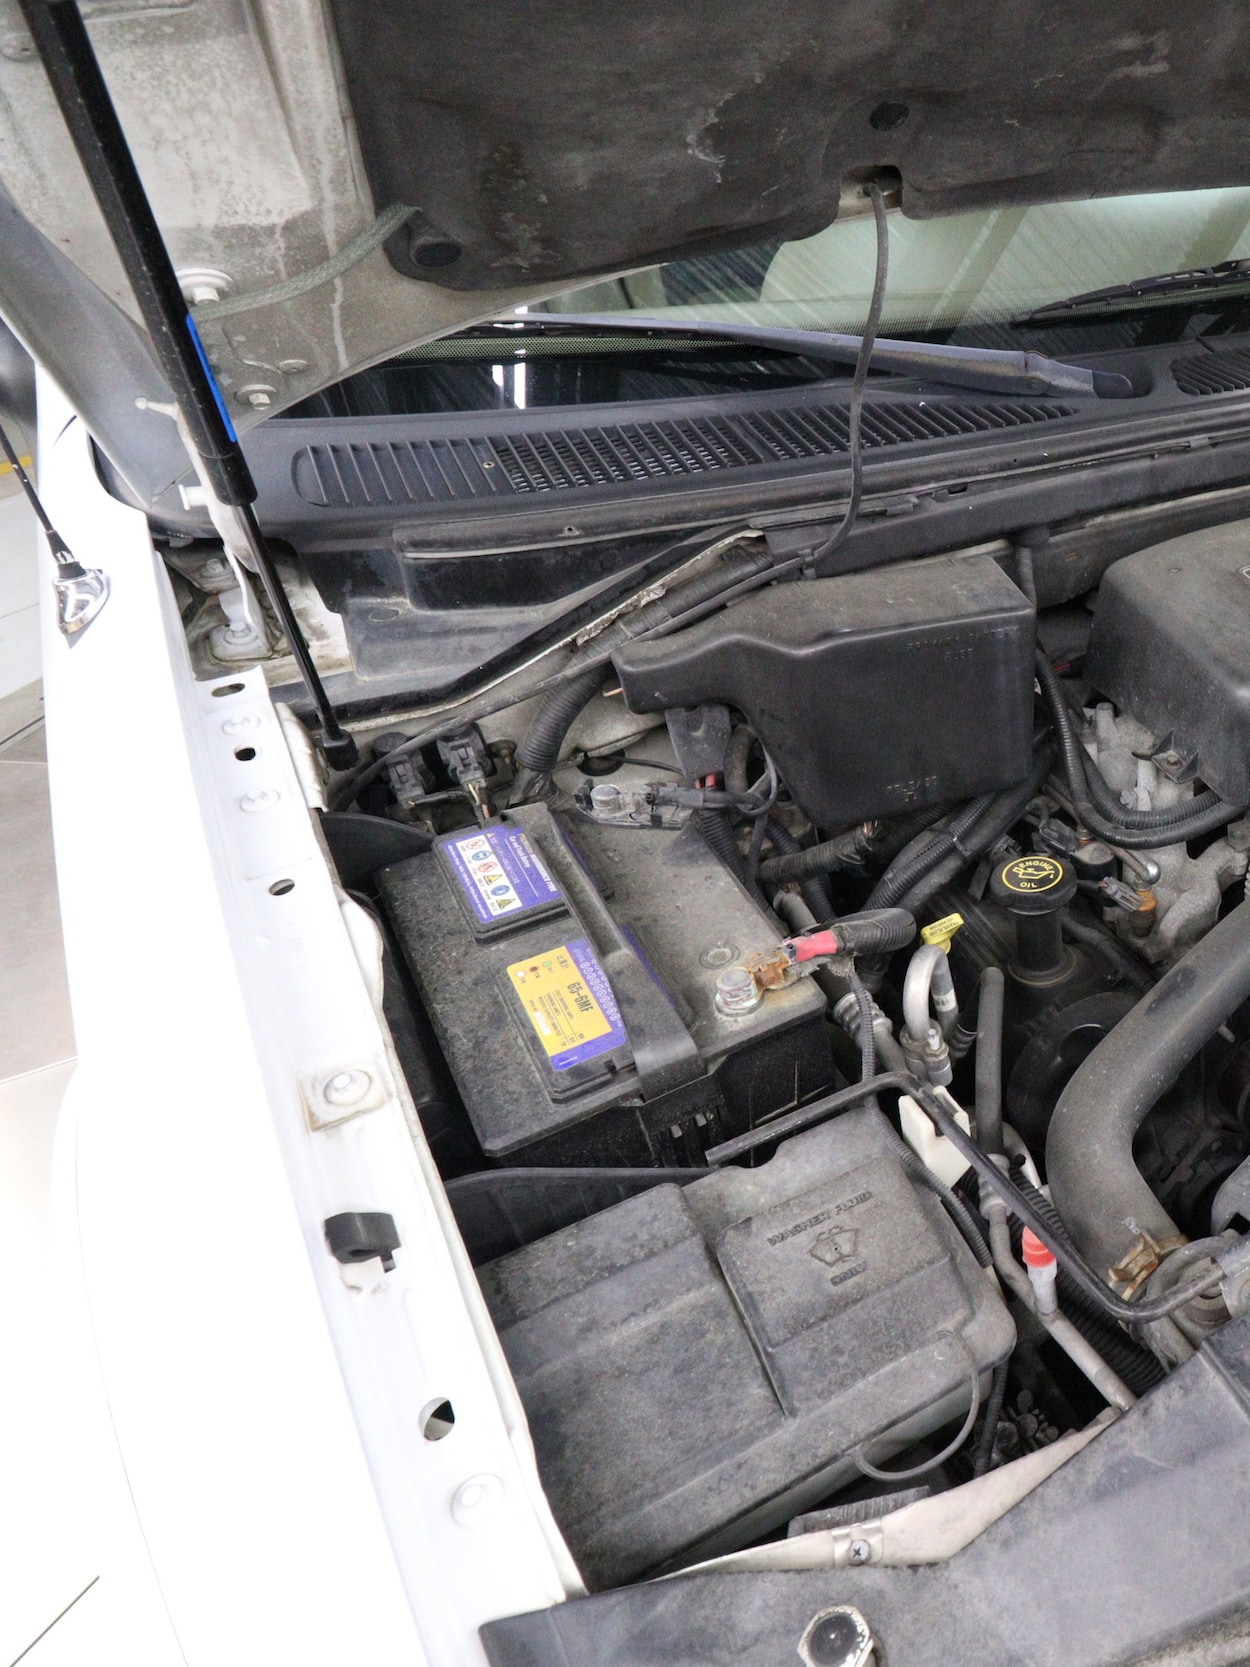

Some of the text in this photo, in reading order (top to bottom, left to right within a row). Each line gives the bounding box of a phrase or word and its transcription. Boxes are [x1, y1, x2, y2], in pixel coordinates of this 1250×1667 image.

[1018, 860, 1054, 871] ENGINE
[1019, 881, 1038, 889] OIL
[566, 980, 594, 1014] 65-6MF
[766, 1190, 873, 1247] WASHER FLUID
[830, 1262, 867, 1287] ONLY
